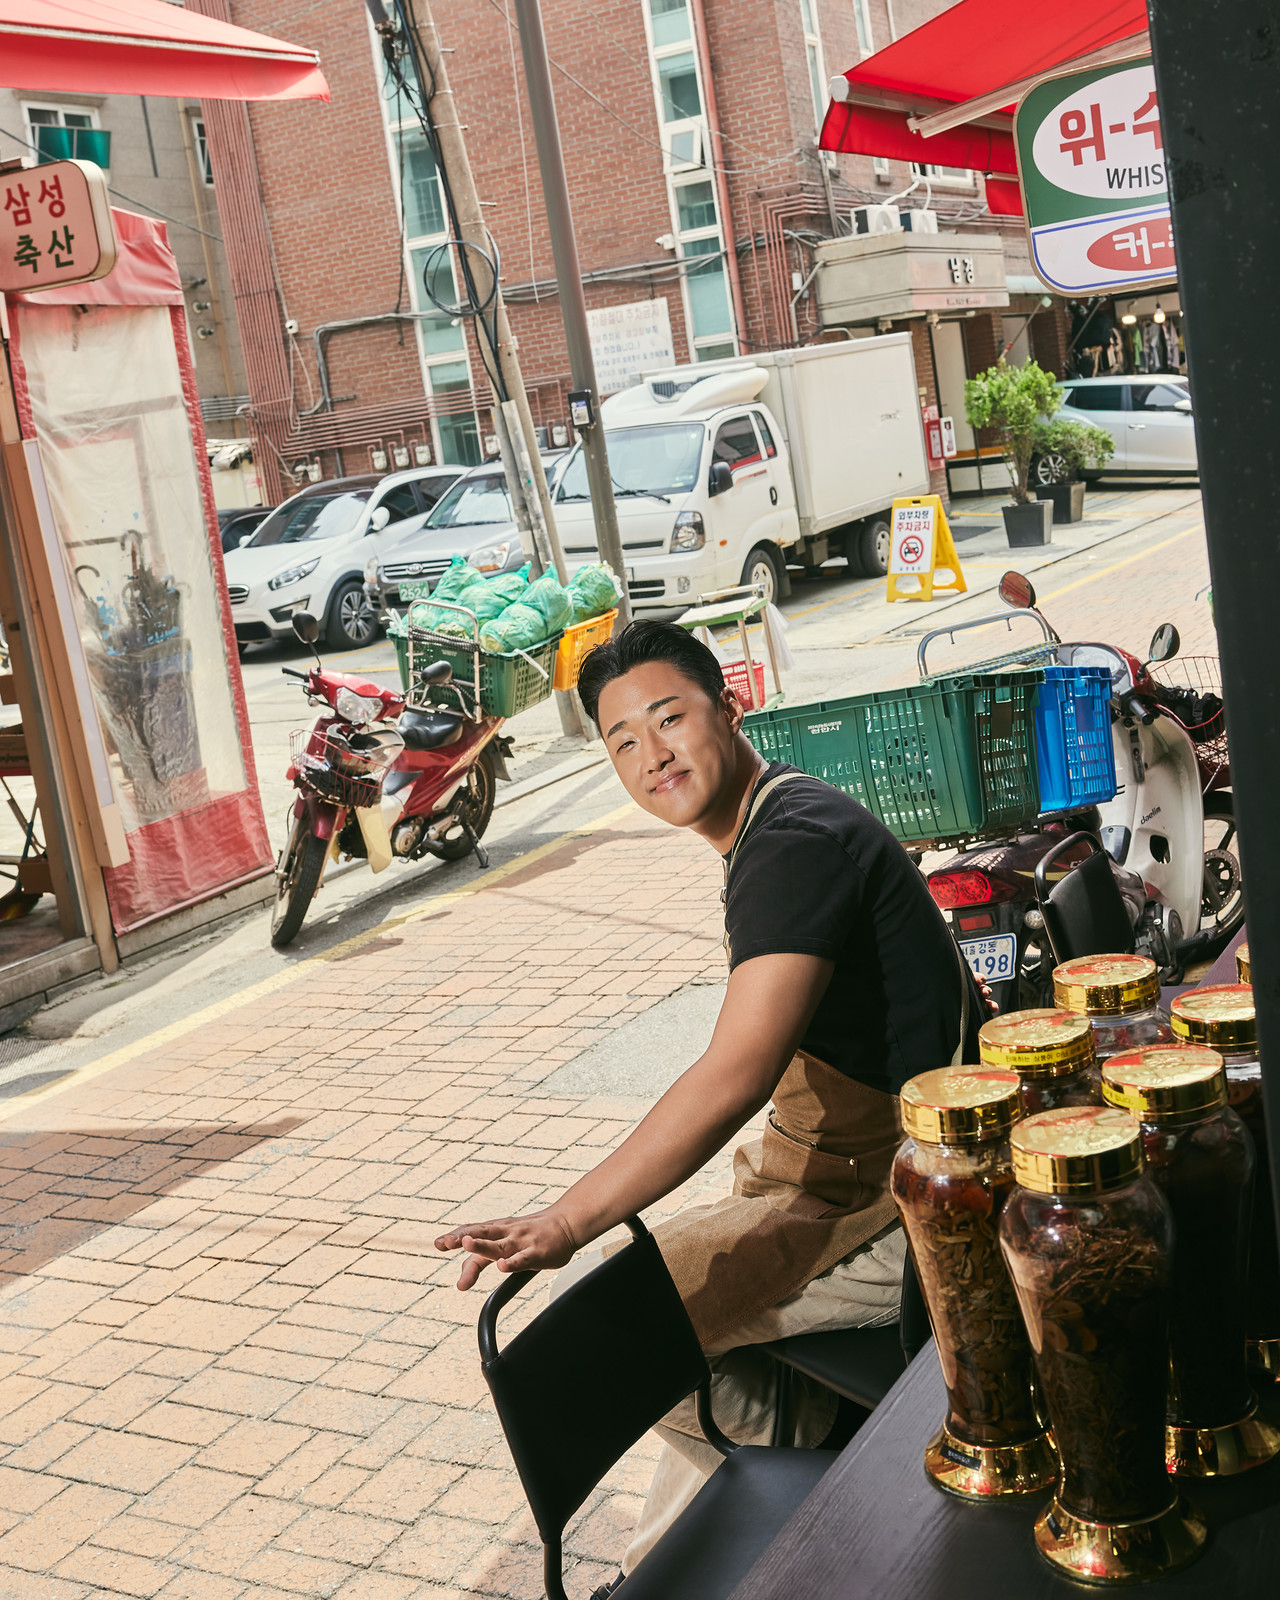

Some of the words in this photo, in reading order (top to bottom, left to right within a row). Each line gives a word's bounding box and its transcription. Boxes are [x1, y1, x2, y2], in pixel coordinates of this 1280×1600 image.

[1106, 163, 1165, 189] WHIS
[4, 174, 66, 227] 삼성
[13, 225, 74, 274] 축산
[1112, 224, 1174, 265] 커-
[898, 510, 929, 520] 외부차량
[897, 521, 931, 532] 주차금지
[400, 587, 428, 600] 2524
[1140, 806, 1162, 825] daelim
[979, 940, 996, 955] 강동
[967, 954, 1008, 975] 198
